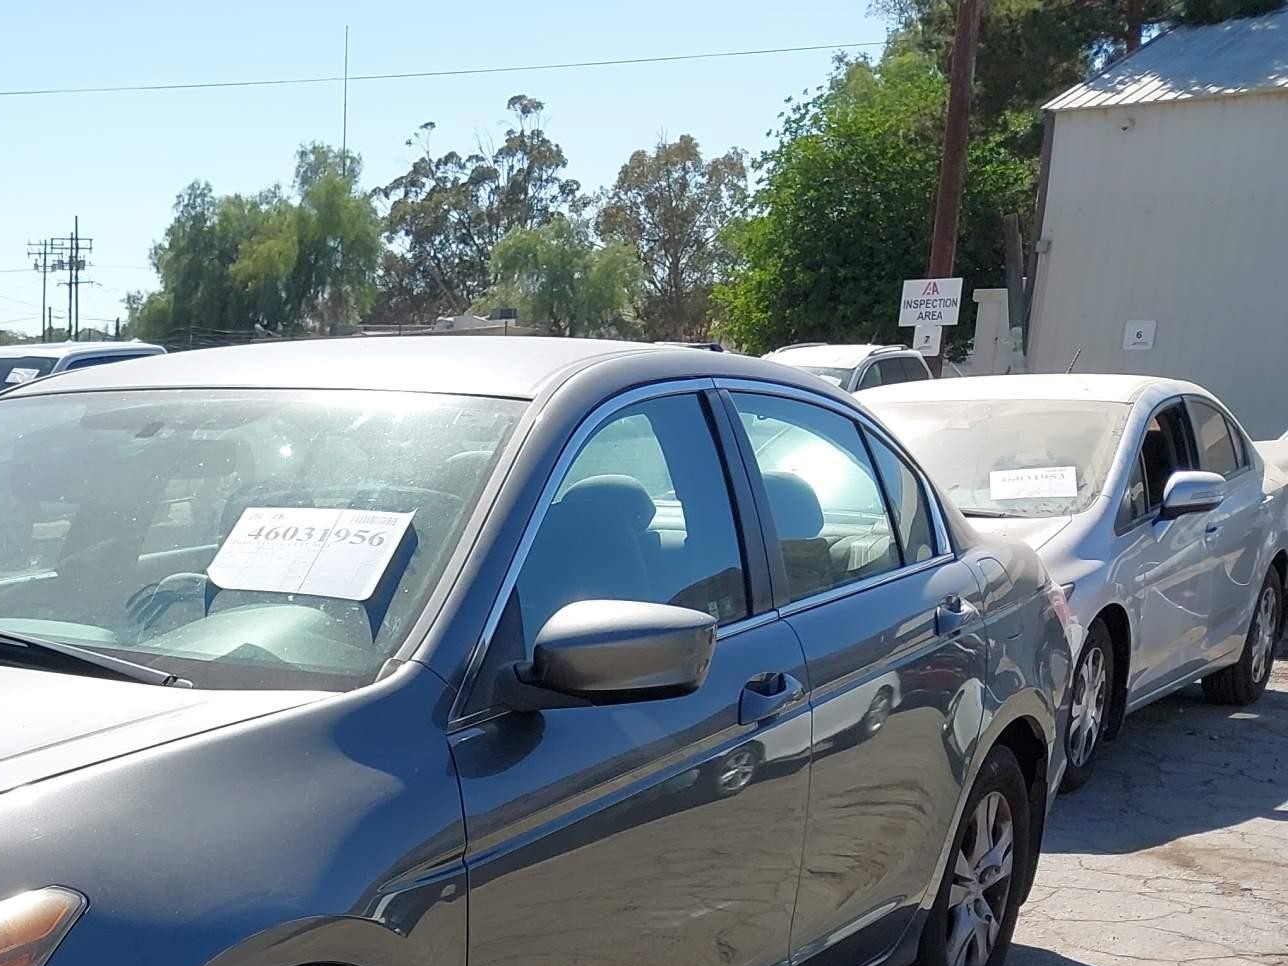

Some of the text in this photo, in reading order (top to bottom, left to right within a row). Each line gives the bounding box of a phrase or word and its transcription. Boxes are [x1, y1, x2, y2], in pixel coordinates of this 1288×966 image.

[903, 298, 958, 310] INSPECTION
[917, 311, 943, 321] AREA
[923, 335, 931, 344] 7
[1135, 330, 1143, 339] 6
[247, 525, 390, 547] 46031956
